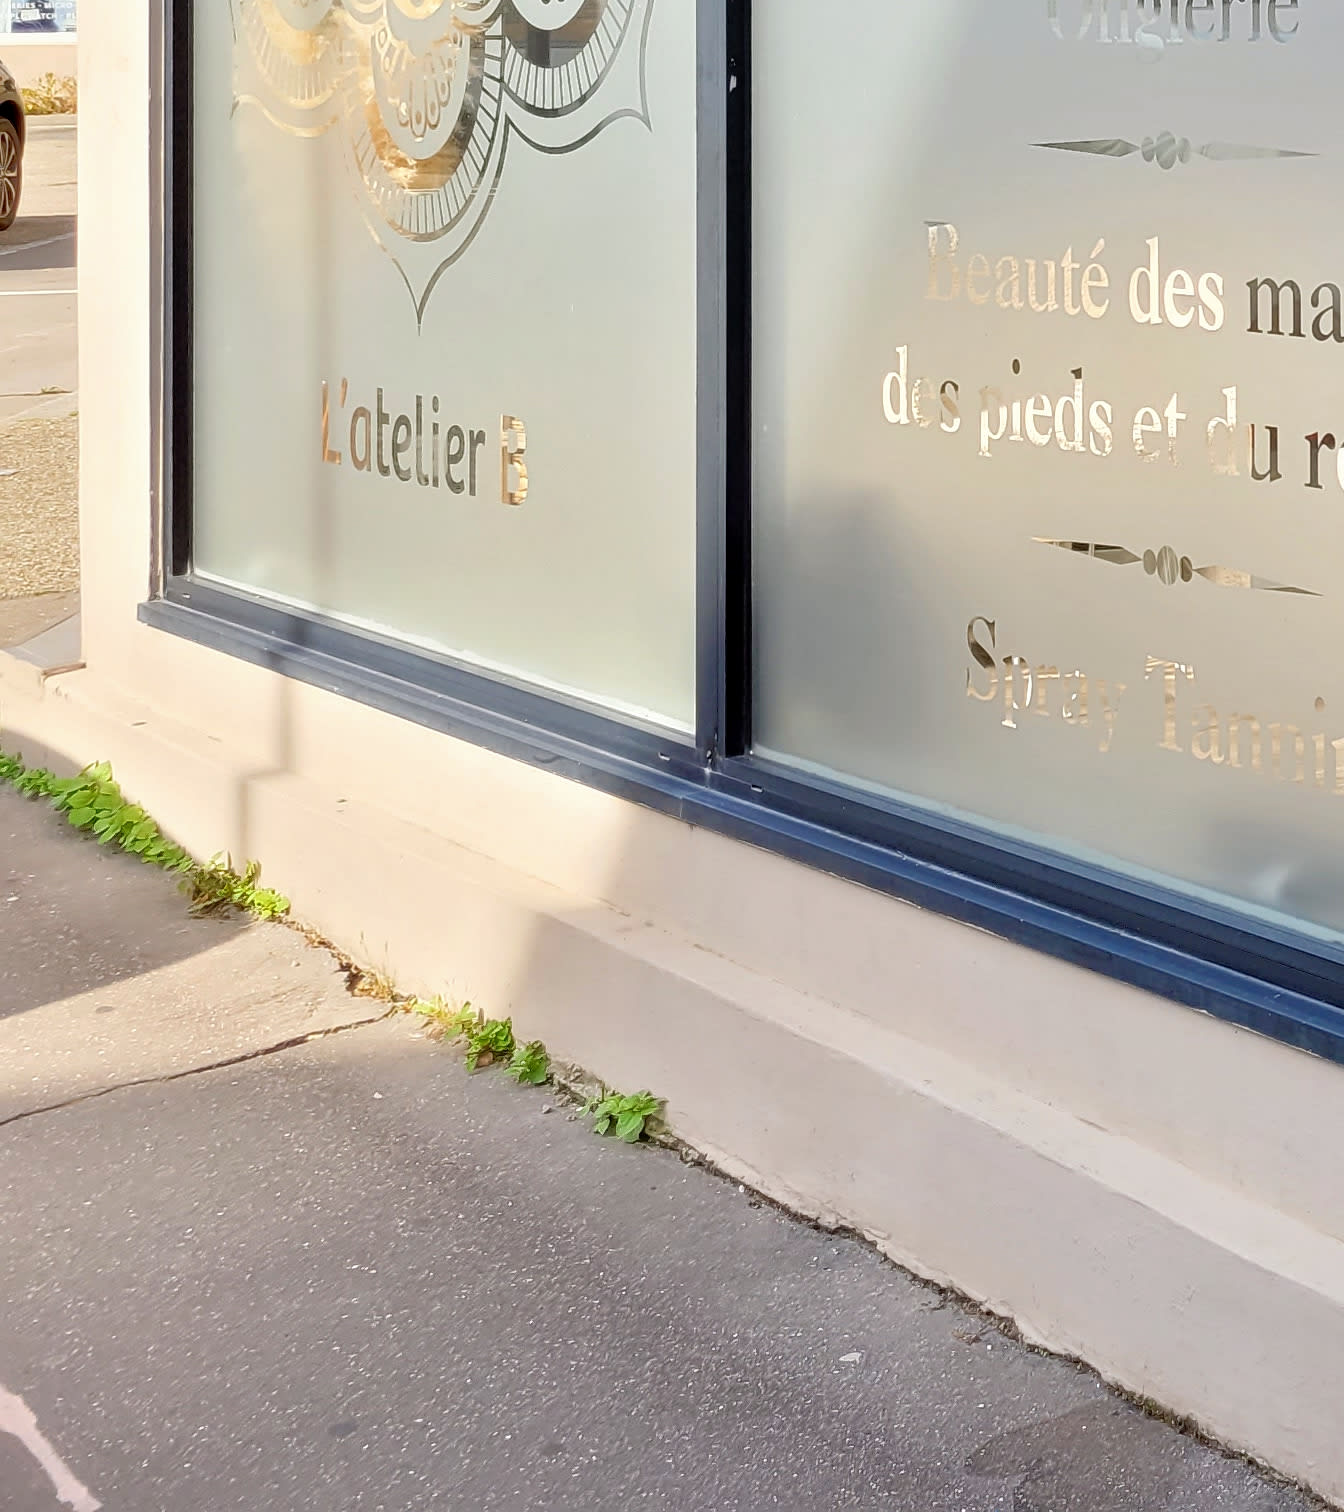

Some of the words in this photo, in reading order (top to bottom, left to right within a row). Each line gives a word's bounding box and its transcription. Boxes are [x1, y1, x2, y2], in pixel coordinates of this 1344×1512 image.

[922, 220, 1110, 318] Beauté
[1129, 237, 1225, 331] des
[500, 414, 528, 506] B
[882, 345, 960, 434] des
[978, 359, 1114, 458] pieds
[1133, 392, 1186, 468] et
[1207, 385, 1283, 481] du
[966, 615, 1126, 753] Spray
